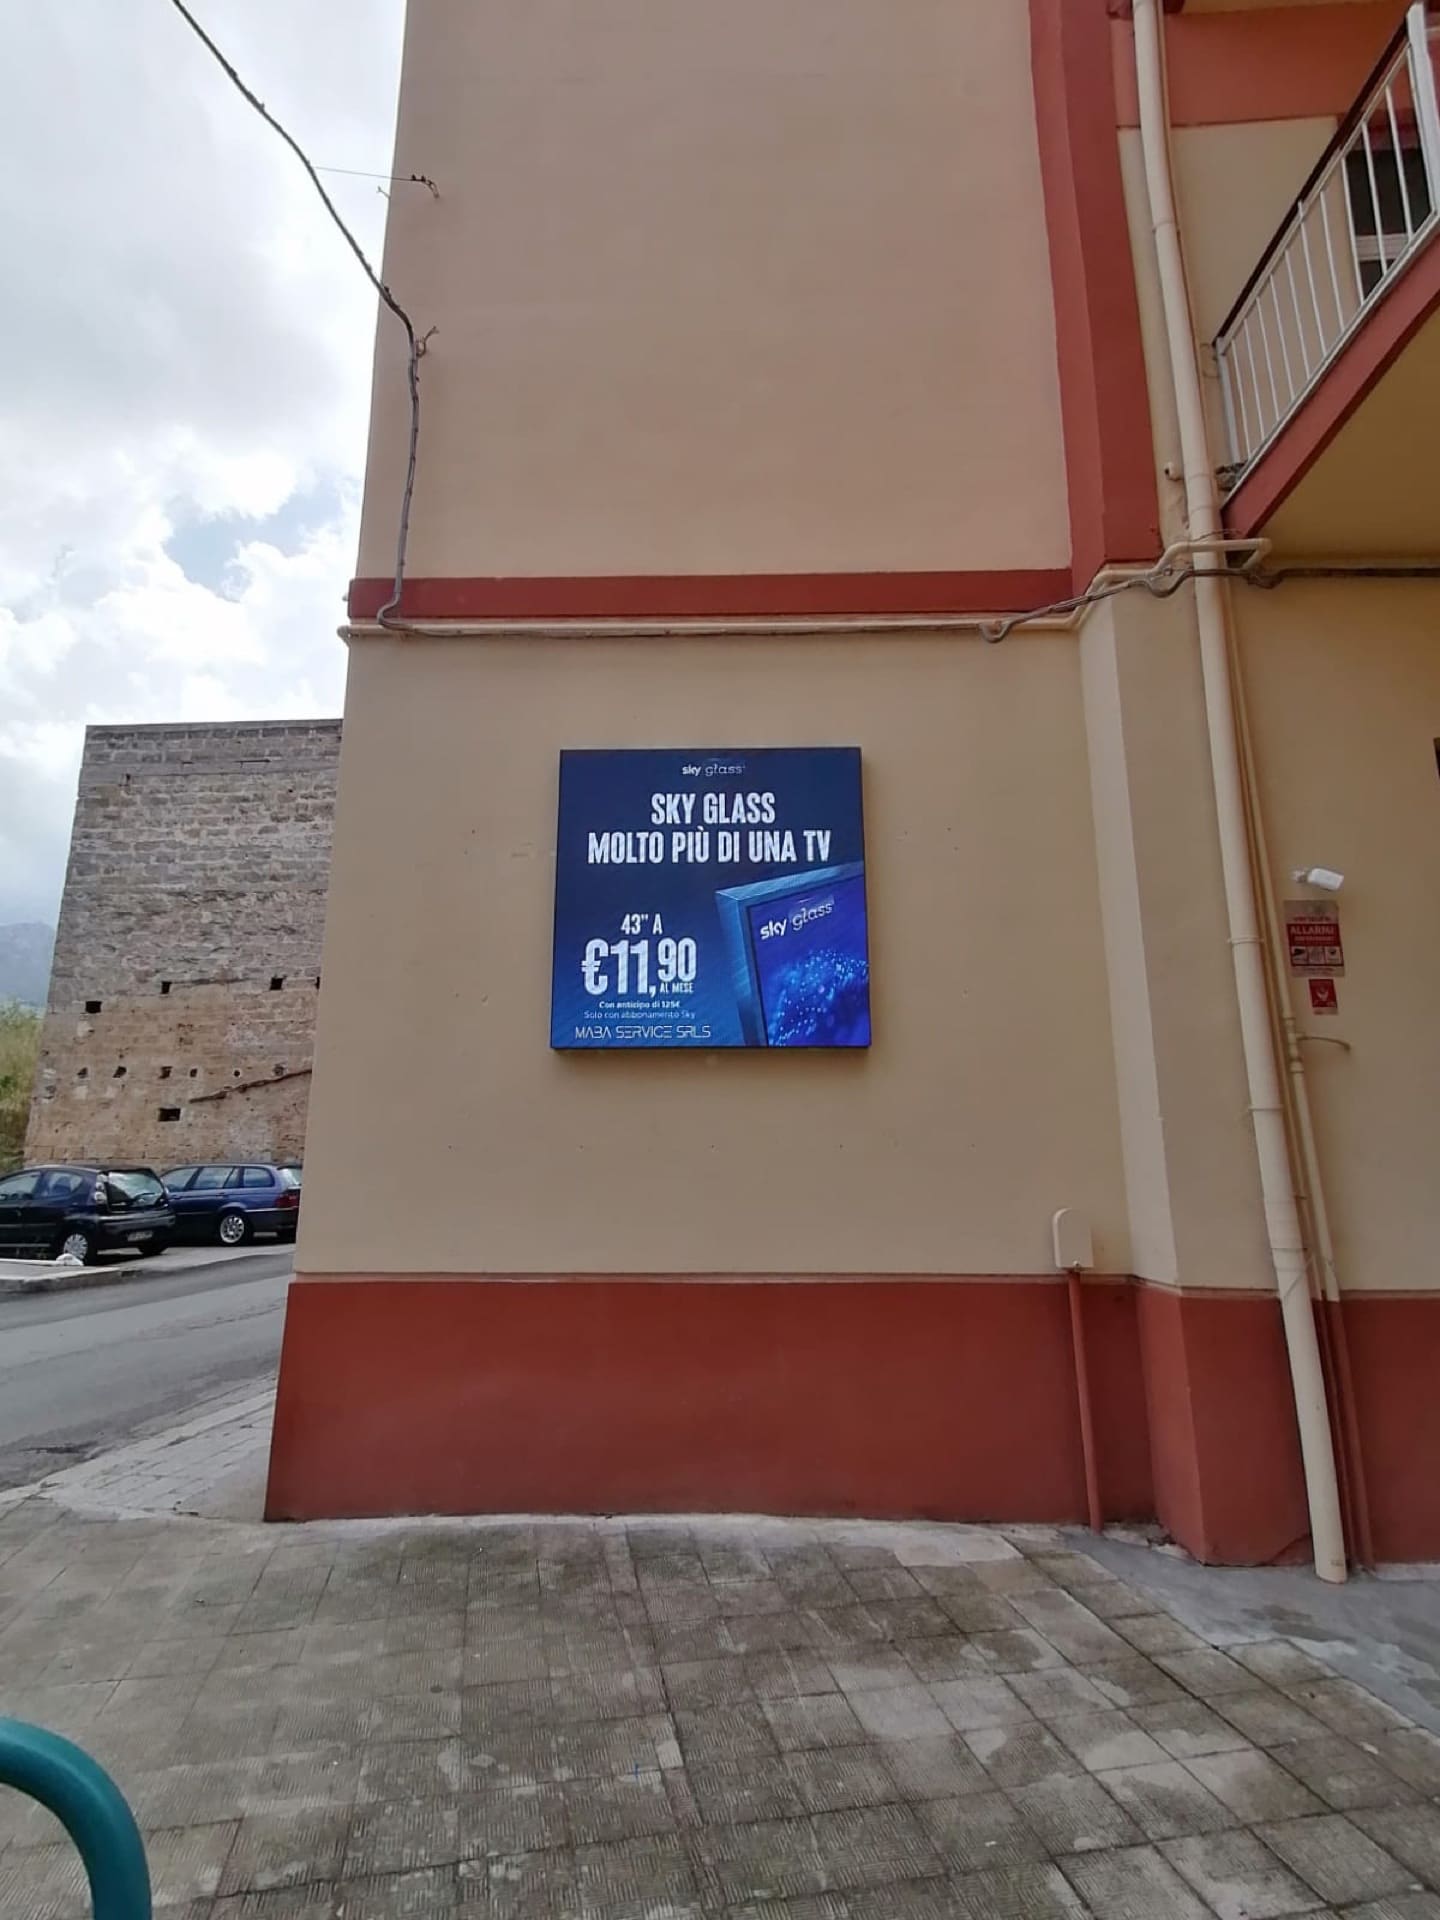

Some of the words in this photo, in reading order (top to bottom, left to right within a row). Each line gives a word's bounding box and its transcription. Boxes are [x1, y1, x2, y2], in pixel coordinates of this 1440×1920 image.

[682, 764, 701, 777] sky
[705, 763, 743, 777] glass
[651, 793, 696, 825] SKY
[703, 792, 776, 824] GLASS
[587, 832, 664, 864] MOLTO
[671, 825, 710, 863] PIÙ
[718, 831, 740, 863] DI
[749, 830, 797, 862] UNA
[803, 830, 831, 862] TV
[620, 913, 648, 935] 43"
[652, 913, 663, 935] A
[760, 918, 787, 940] sky
[792, 903, 833, 931] glass
[671, 982, 694, 993] MESE
[599, 1001, 614, 1009] Con
[616, 1001, 650, 1010] anticipo
[575, 1026, 612, 1038] MABA
[616, 1026, 672, 1038] SERVICE
[676, 1026, 711, 1038] SRLS
